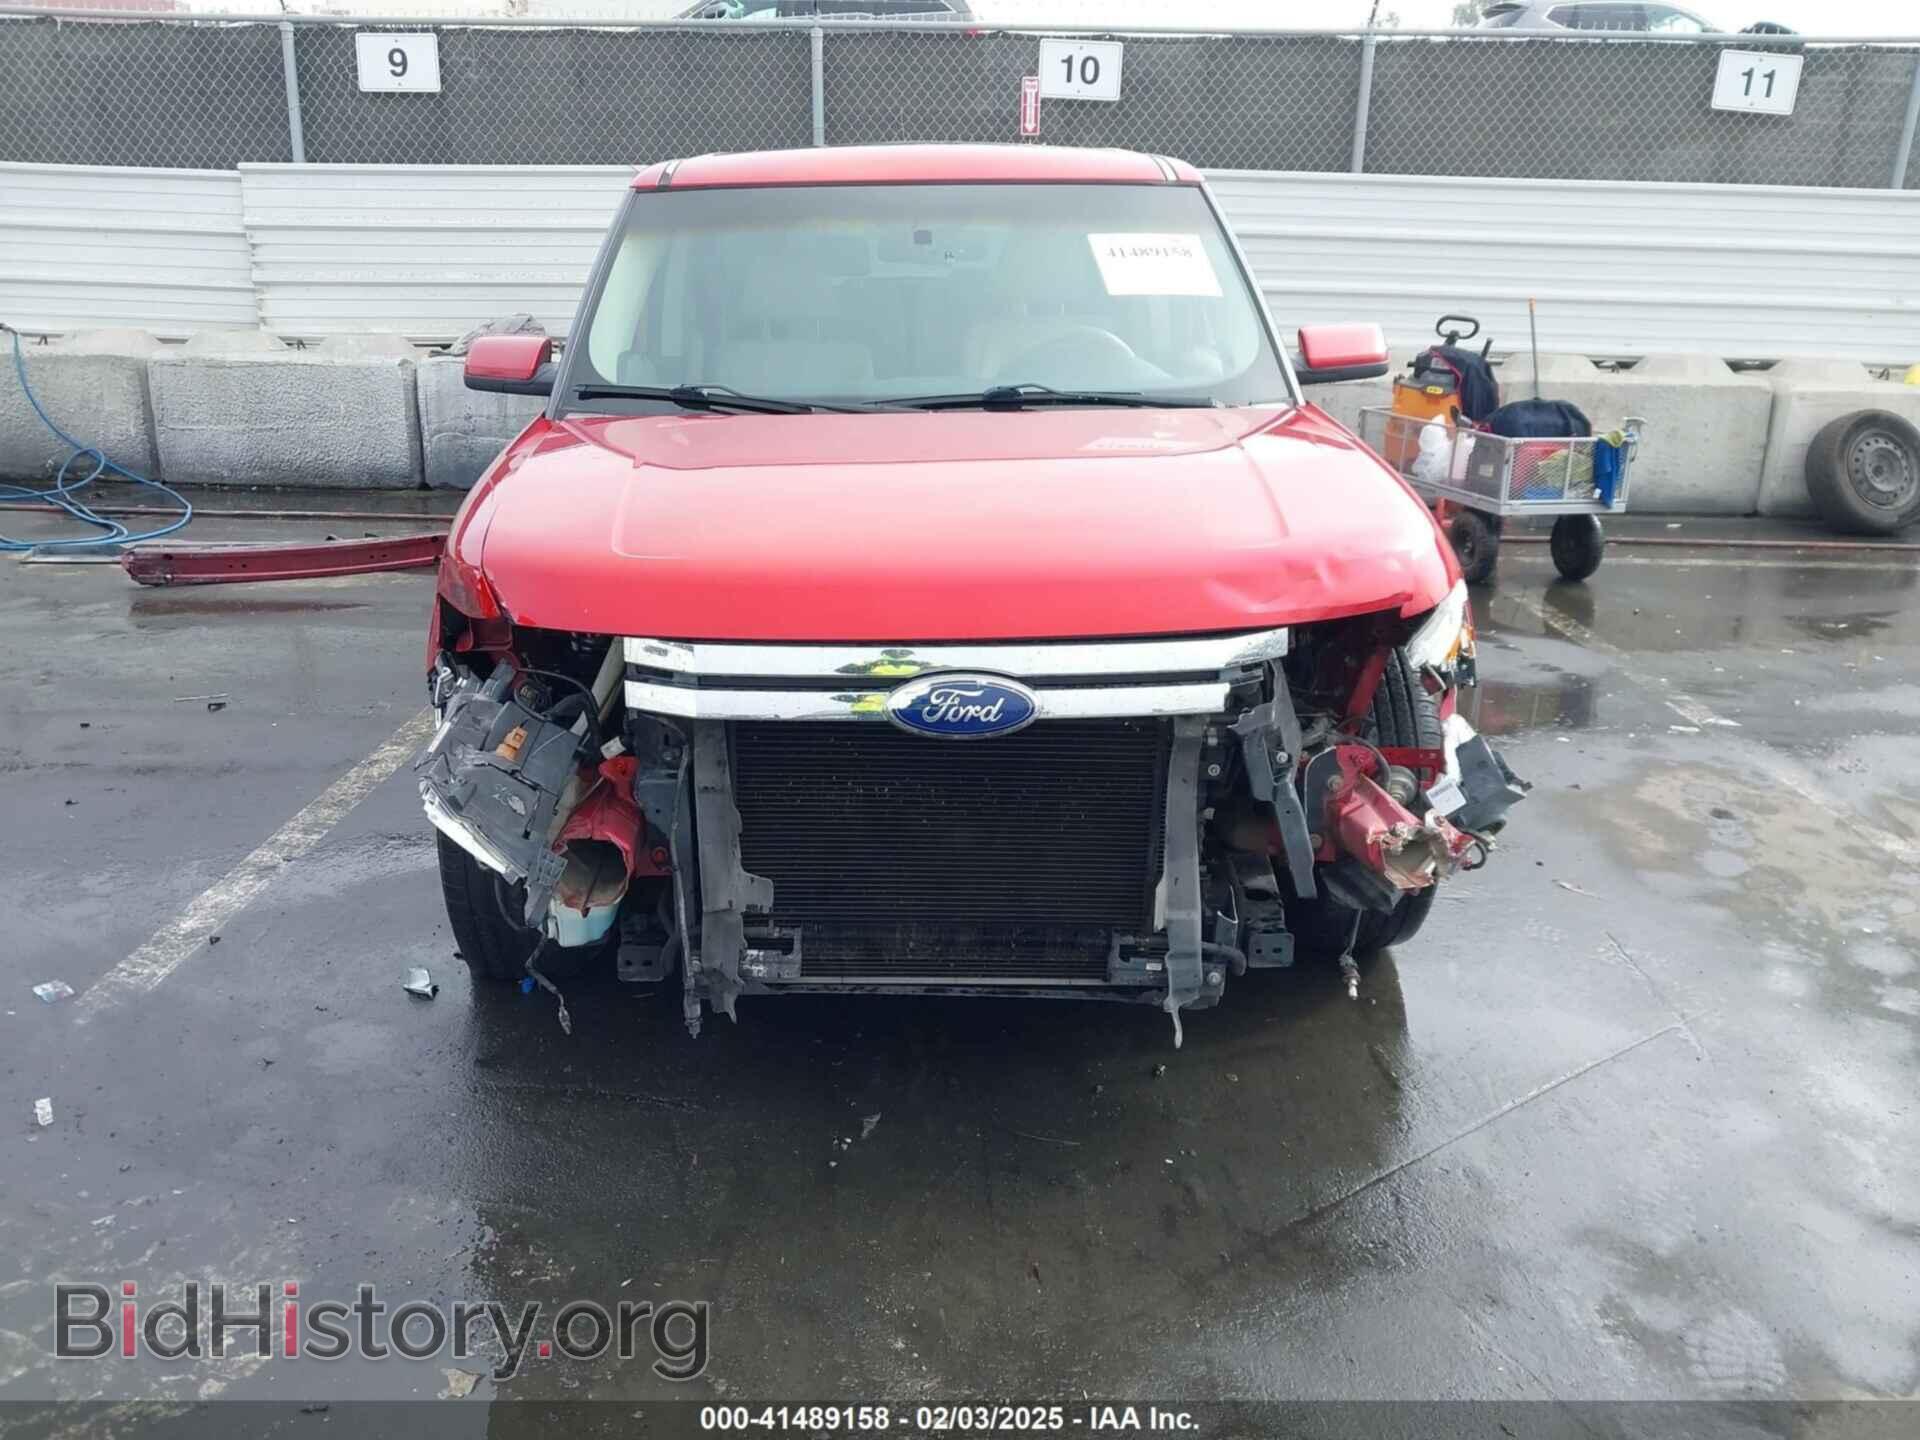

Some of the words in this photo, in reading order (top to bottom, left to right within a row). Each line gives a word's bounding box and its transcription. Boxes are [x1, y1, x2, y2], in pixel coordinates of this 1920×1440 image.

[388, 47, 408, 77] 9
[1060, 54, 1100, 85] 10
[1741, 67, 1776, 98] 11
[921, 687, 1004, 723] Ford
